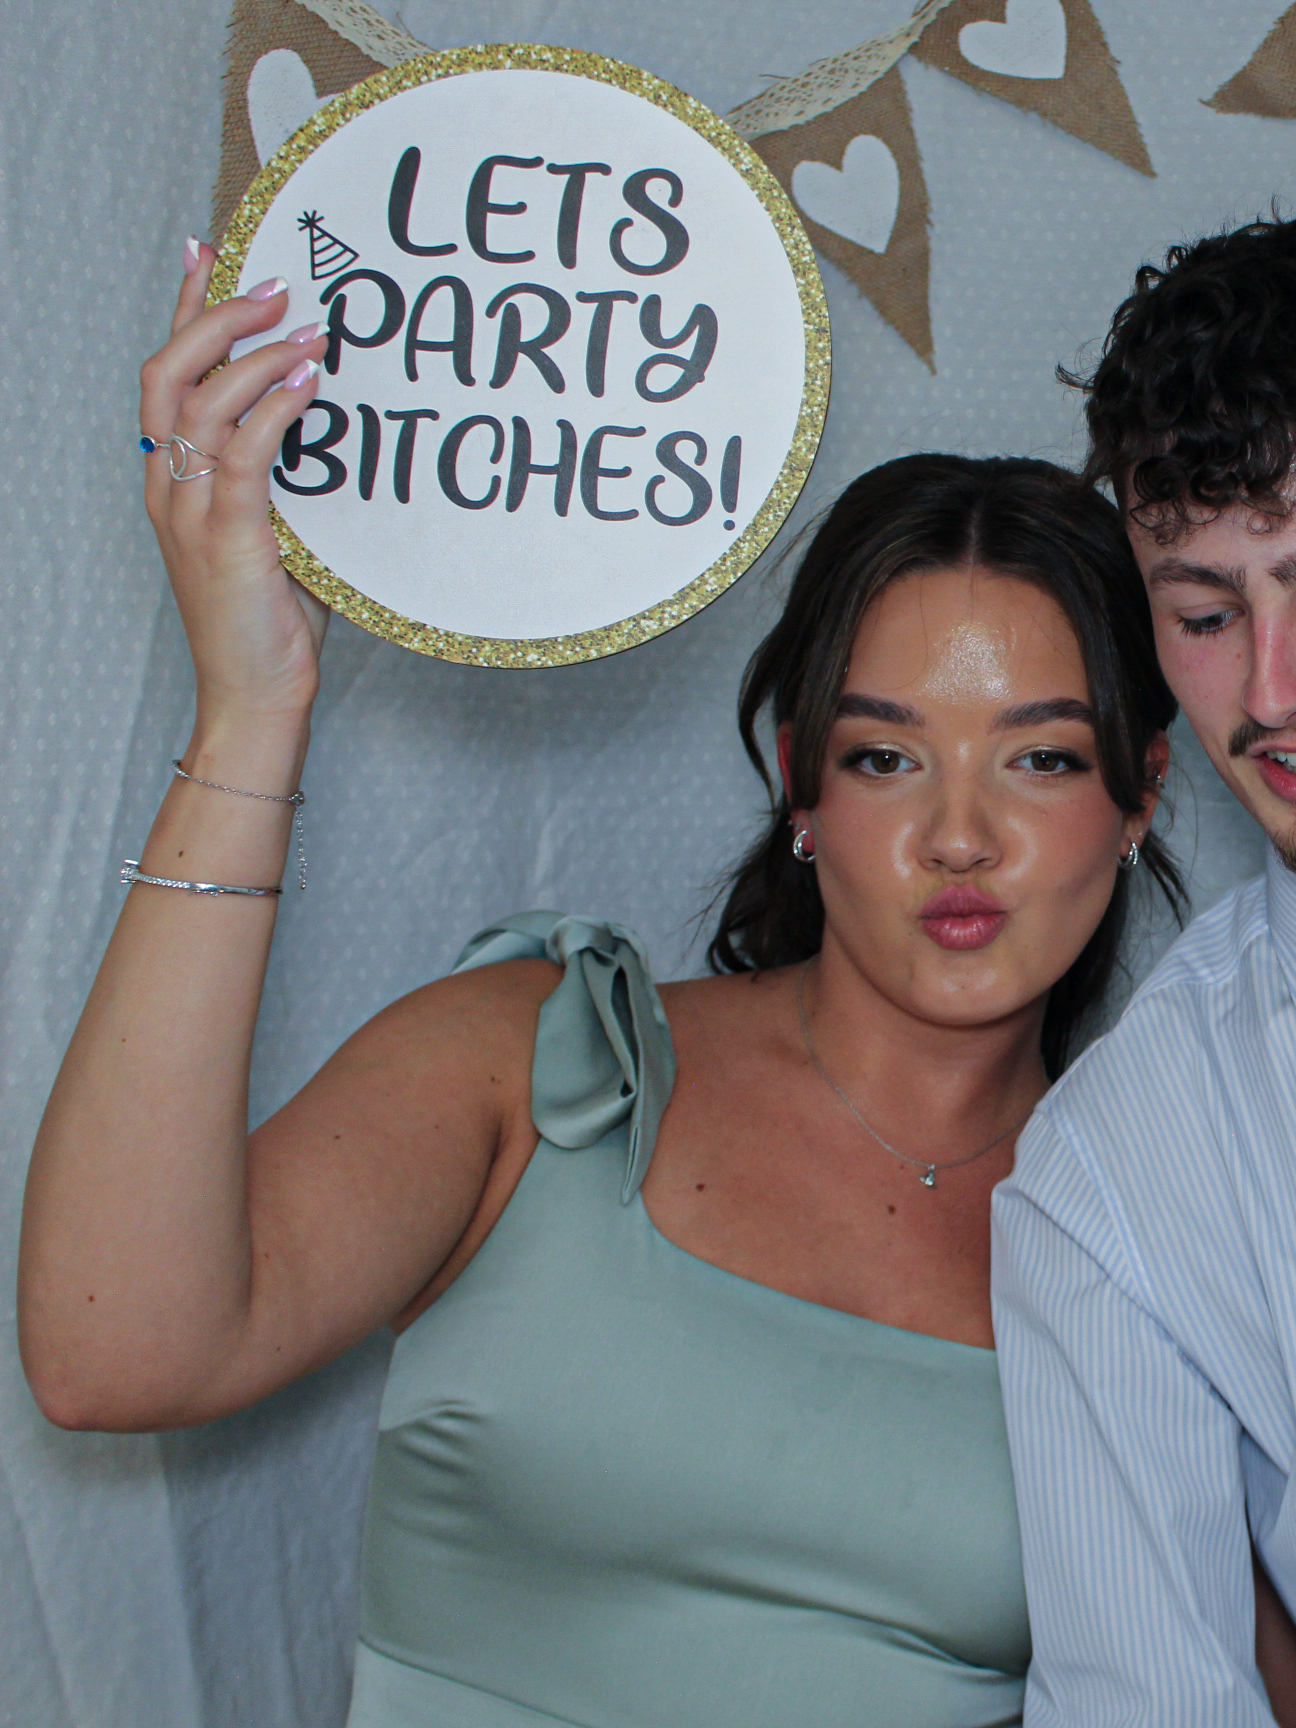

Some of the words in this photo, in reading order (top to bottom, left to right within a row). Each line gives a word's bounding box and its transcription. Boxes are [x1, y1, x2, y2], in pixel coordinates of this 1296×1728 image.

[387, 146, 690, 276] LETS
[319, 268, 718, 403] PARTY
[272, 398, 742, 531] BITCHES!
